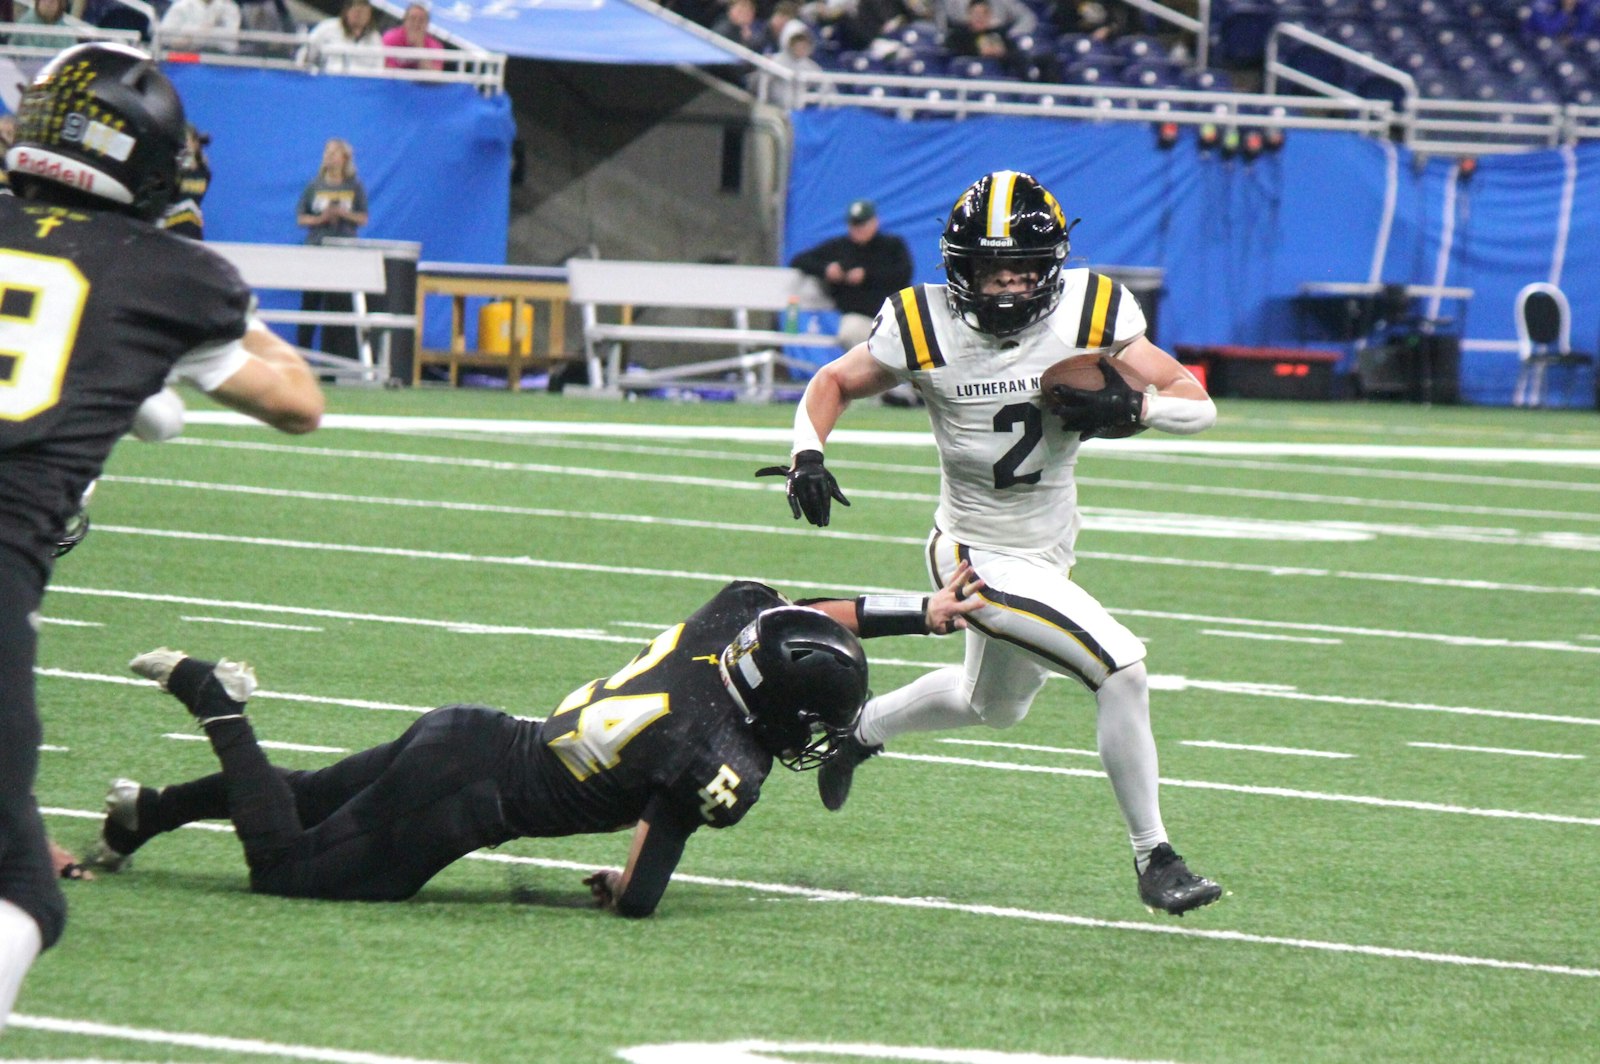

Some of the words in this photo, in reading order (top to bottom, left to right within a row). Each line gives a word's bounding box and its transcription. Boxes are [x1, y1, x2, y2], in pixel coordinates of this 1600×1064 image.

[17, 151, 96, 192] Riddell
[980, 238, 1014, 248] Riddell
[956, 379, 1027, 397] LUTHERAN
[993, 402, 1043, 489] 2
